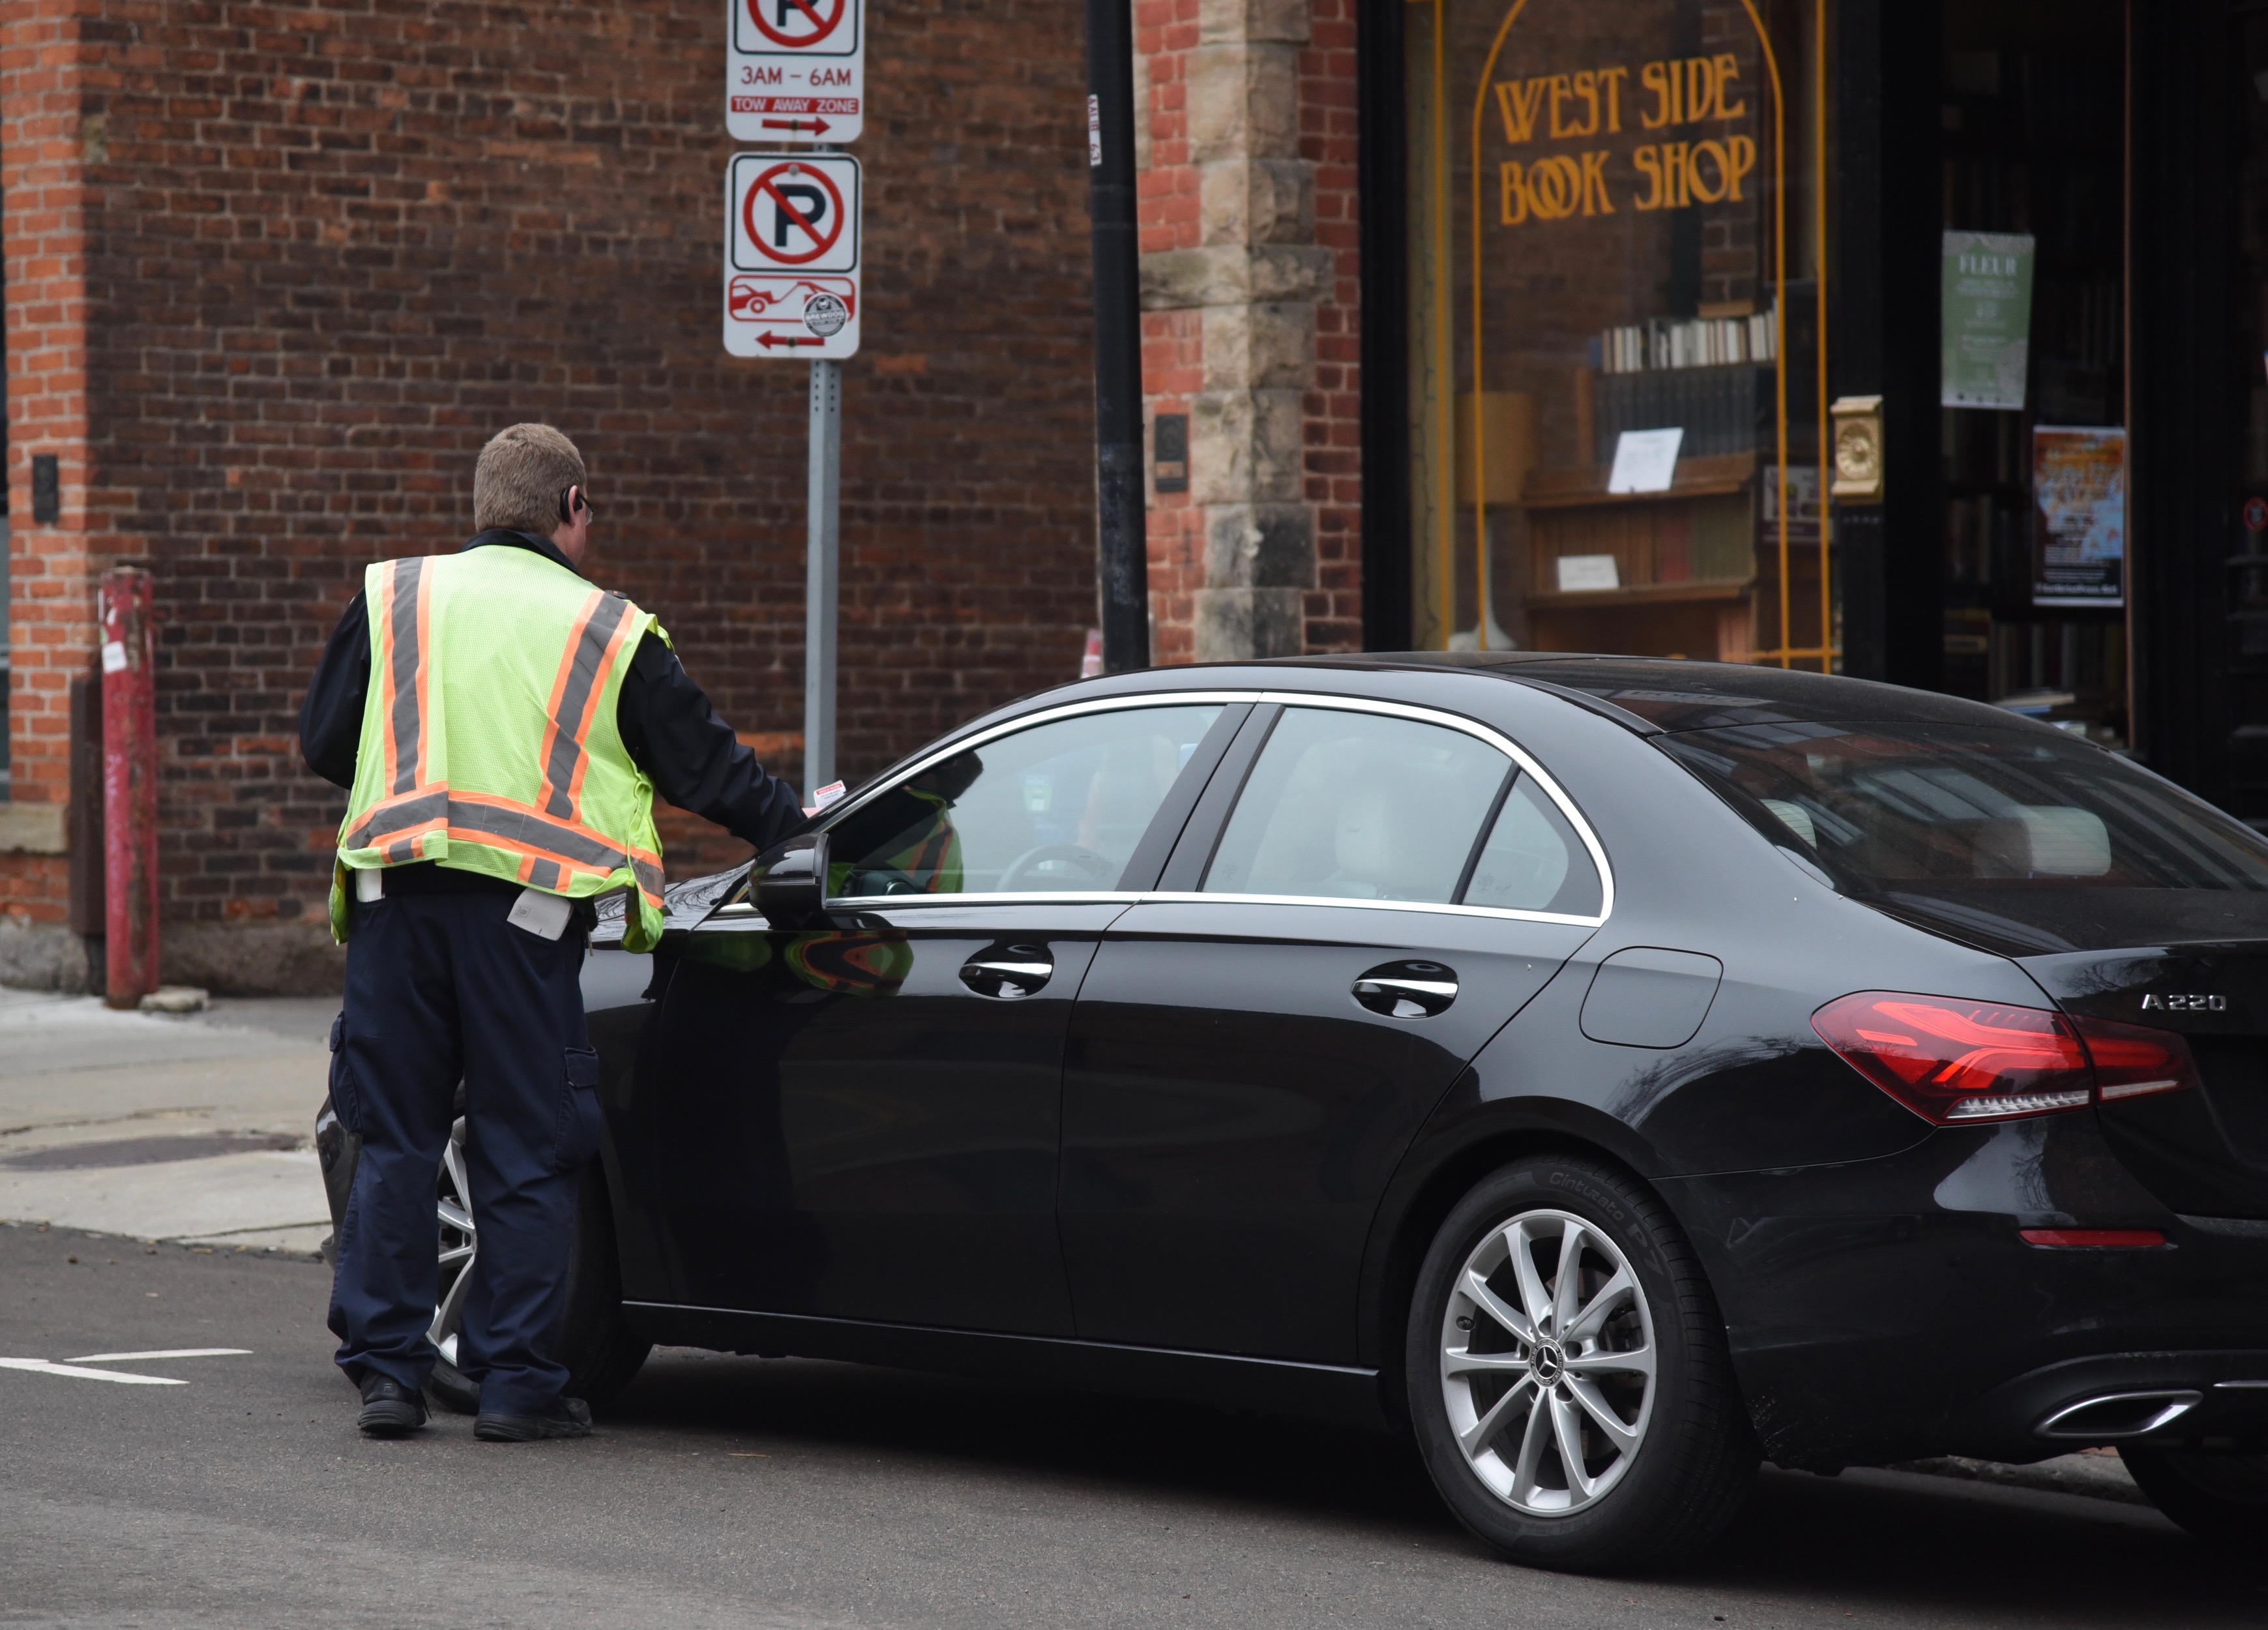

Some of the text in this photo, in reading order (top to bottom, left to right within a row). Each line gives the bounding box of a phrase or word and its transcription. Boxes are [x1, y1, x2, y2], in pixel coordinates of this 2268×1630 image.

[741, 66, 782, 85] 3AM
[810, 67, 851, 86] 6AM
[1494, 52, 1746, 144] WEST SIDE
[733, 98, 857, 113] TOW AWAY ZONE
[1500, 134, 1756, 226] BOOK SHOP
